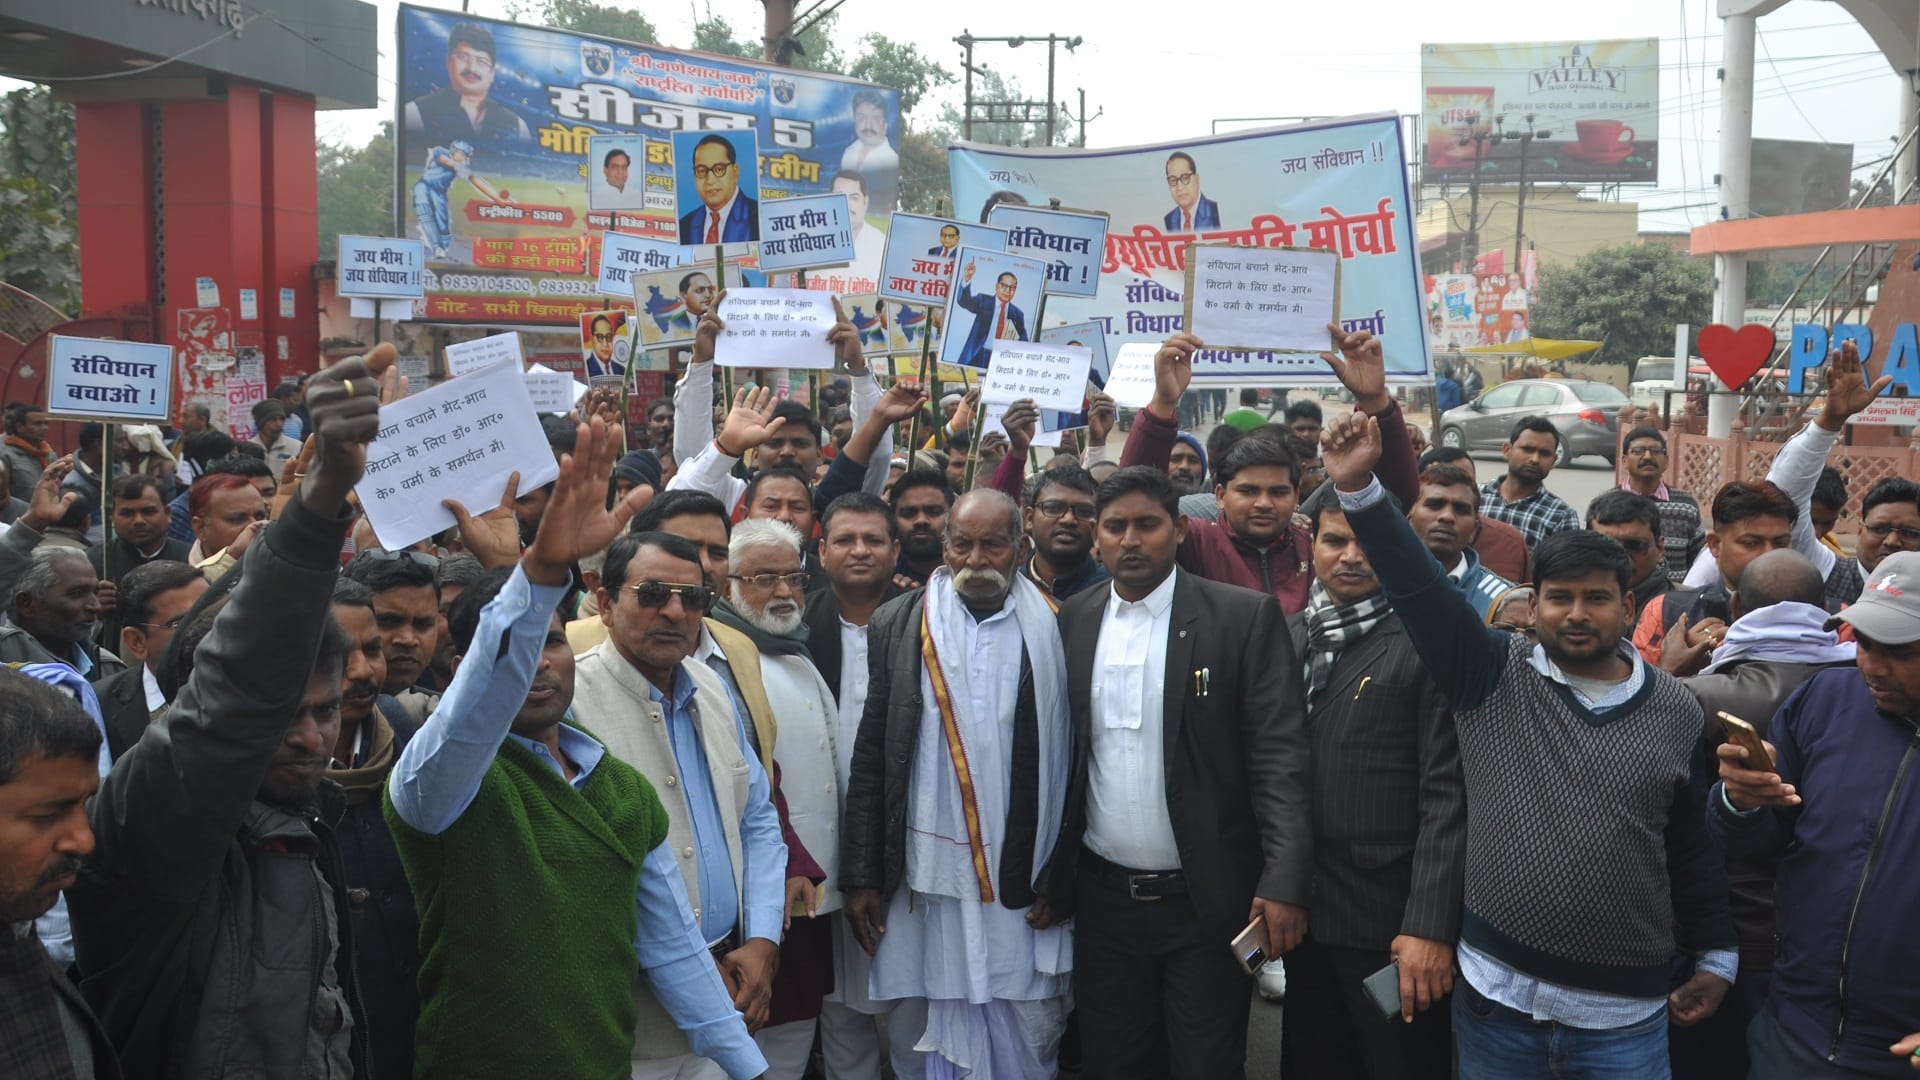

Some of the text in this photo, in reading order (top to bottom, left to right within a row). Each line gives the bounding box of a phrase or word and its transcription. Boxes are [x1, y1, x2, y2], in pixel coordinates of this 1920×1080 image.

[1558, 55, 1593, 68] TEA
[1533, 67, 1622, 89] VALLEY
[773, 118, 814, 149] 5
[1281, 157, 1307, 174] जय
[1312, 147, 1365, 171] संविधान
[989, 170, 1010, 184] जय
[532, 209, 563, 222] 5500
[769, 208, 839, 232] जय भीम !
[522, 242, 538, 252] 16
[762, 240, 786, 256] जय
[353, 247, 413, 266] जय भीम !
[616, 247, 642, 266] जय
[644, 245, 672, 269] भीम
[605, 266, 626, 283] जय
[911, 258, 942, 276] जय
[1081, 265, 1089, 284] !
[1207, 260, 1241, 271] संविधान
[1246, 262, 1269, 272] बचाने
[344, 268, 366, 283] जय
[888, 275, 918, 294] जय
[540, 281, 599, 295] 9839324
[1206, 279, 1232, 290] मिटाने
[1237, 280, 1246, 290] के
[1250, 280, 1268, 292] लिए
[483, 301, 520, 316] सभी
[1223, 300, 1240, 311] वर्मा
[1244, 300, 1253, 311] के
[1258, 302, 1287, 313] समर्थन
[66, 384, 156, 405] बचाओ !
[404, 407, 438, 429] बचाने
[442, 389, 487, 414] भेद-भाव
[365, 451, 402, 476] मिटाने
[406, 445, 419, 458] के
[423, 433, 447, 452] लिए
[400, 470, 425, 490] वर्मा
[428, 466, 441, 478] के
[445, 448, 486, 472] समर्थन
